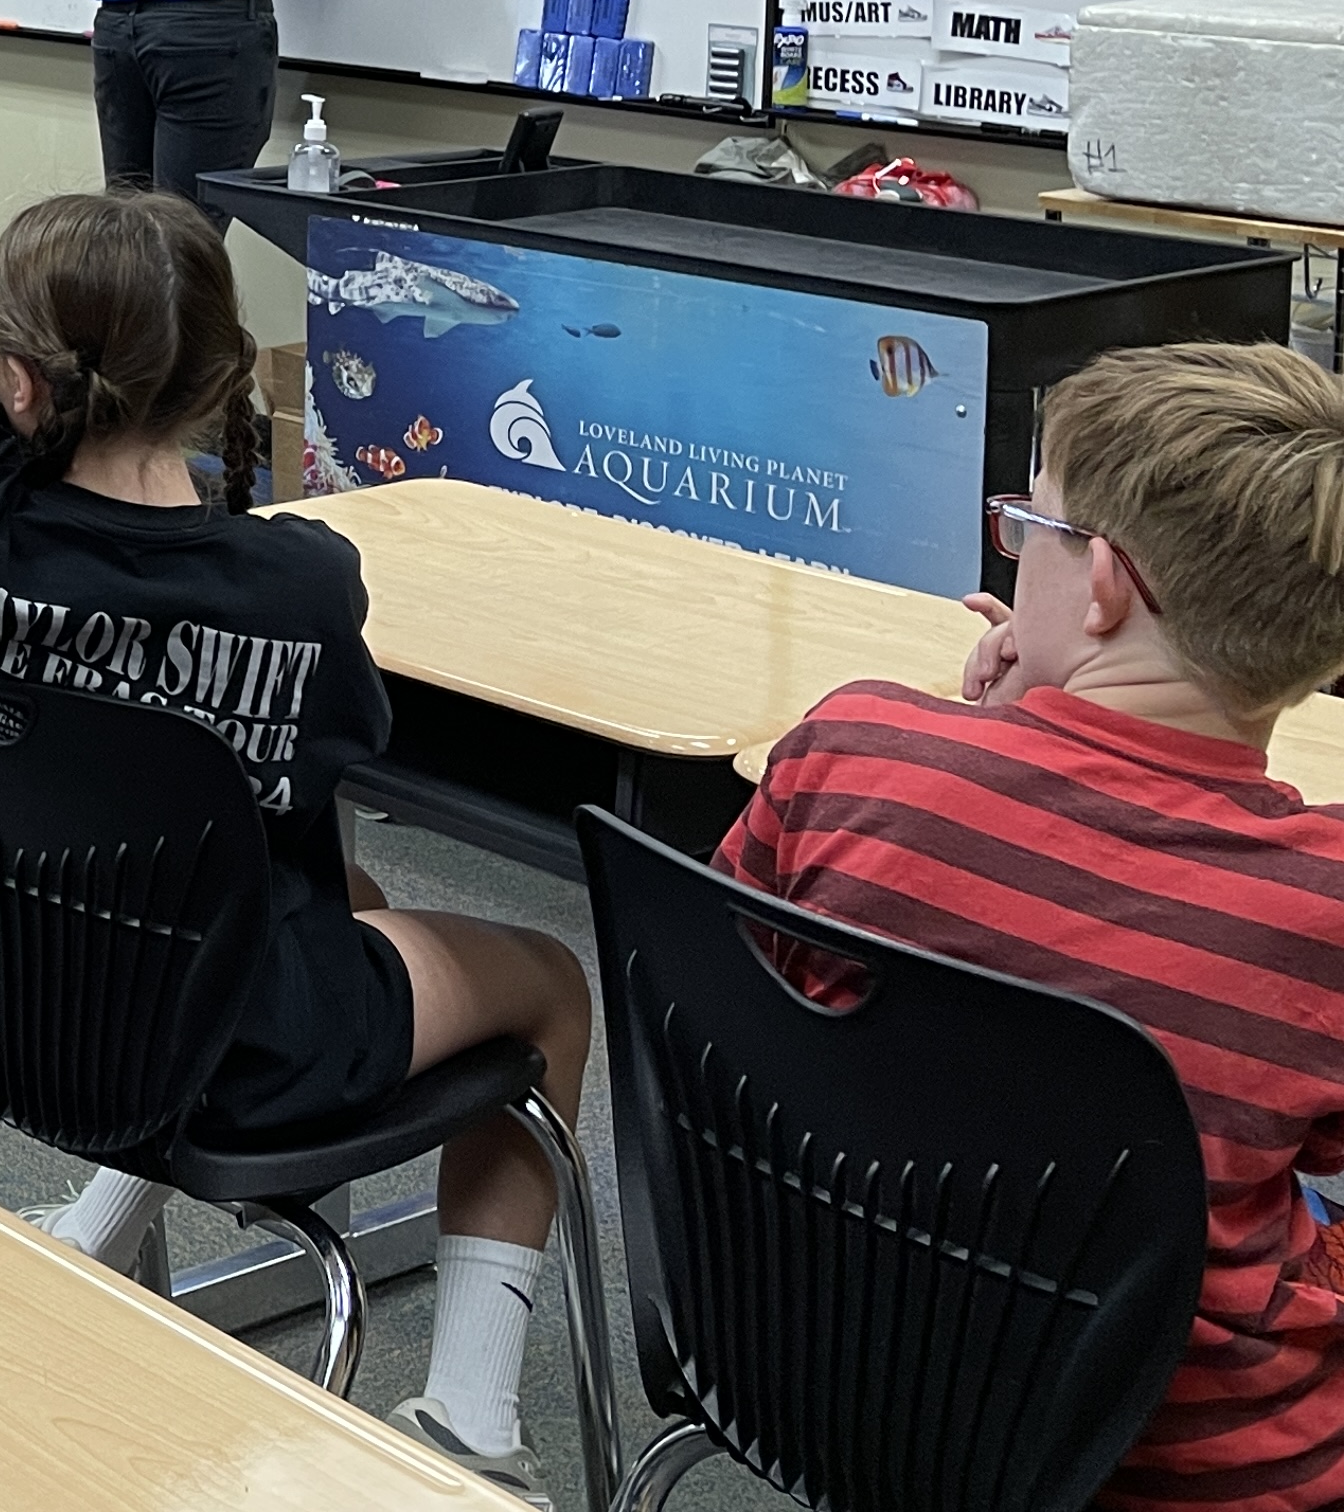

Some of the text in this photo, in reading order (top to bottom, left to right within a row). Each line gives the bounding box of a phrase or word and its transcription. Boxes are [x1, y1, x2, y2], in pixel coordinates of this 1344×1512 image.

[801, 0, 892, 23] MUS/ART
[951, 11, 1022, 45] MATH
[933, 83, 1027, 116] LIBRARY
[579, 420, 849, 491] LOVELAND LIVING PLANET
[572, 443, 846, 533] AQUARIUM
[155, 620, 322, 719] SWIFT
